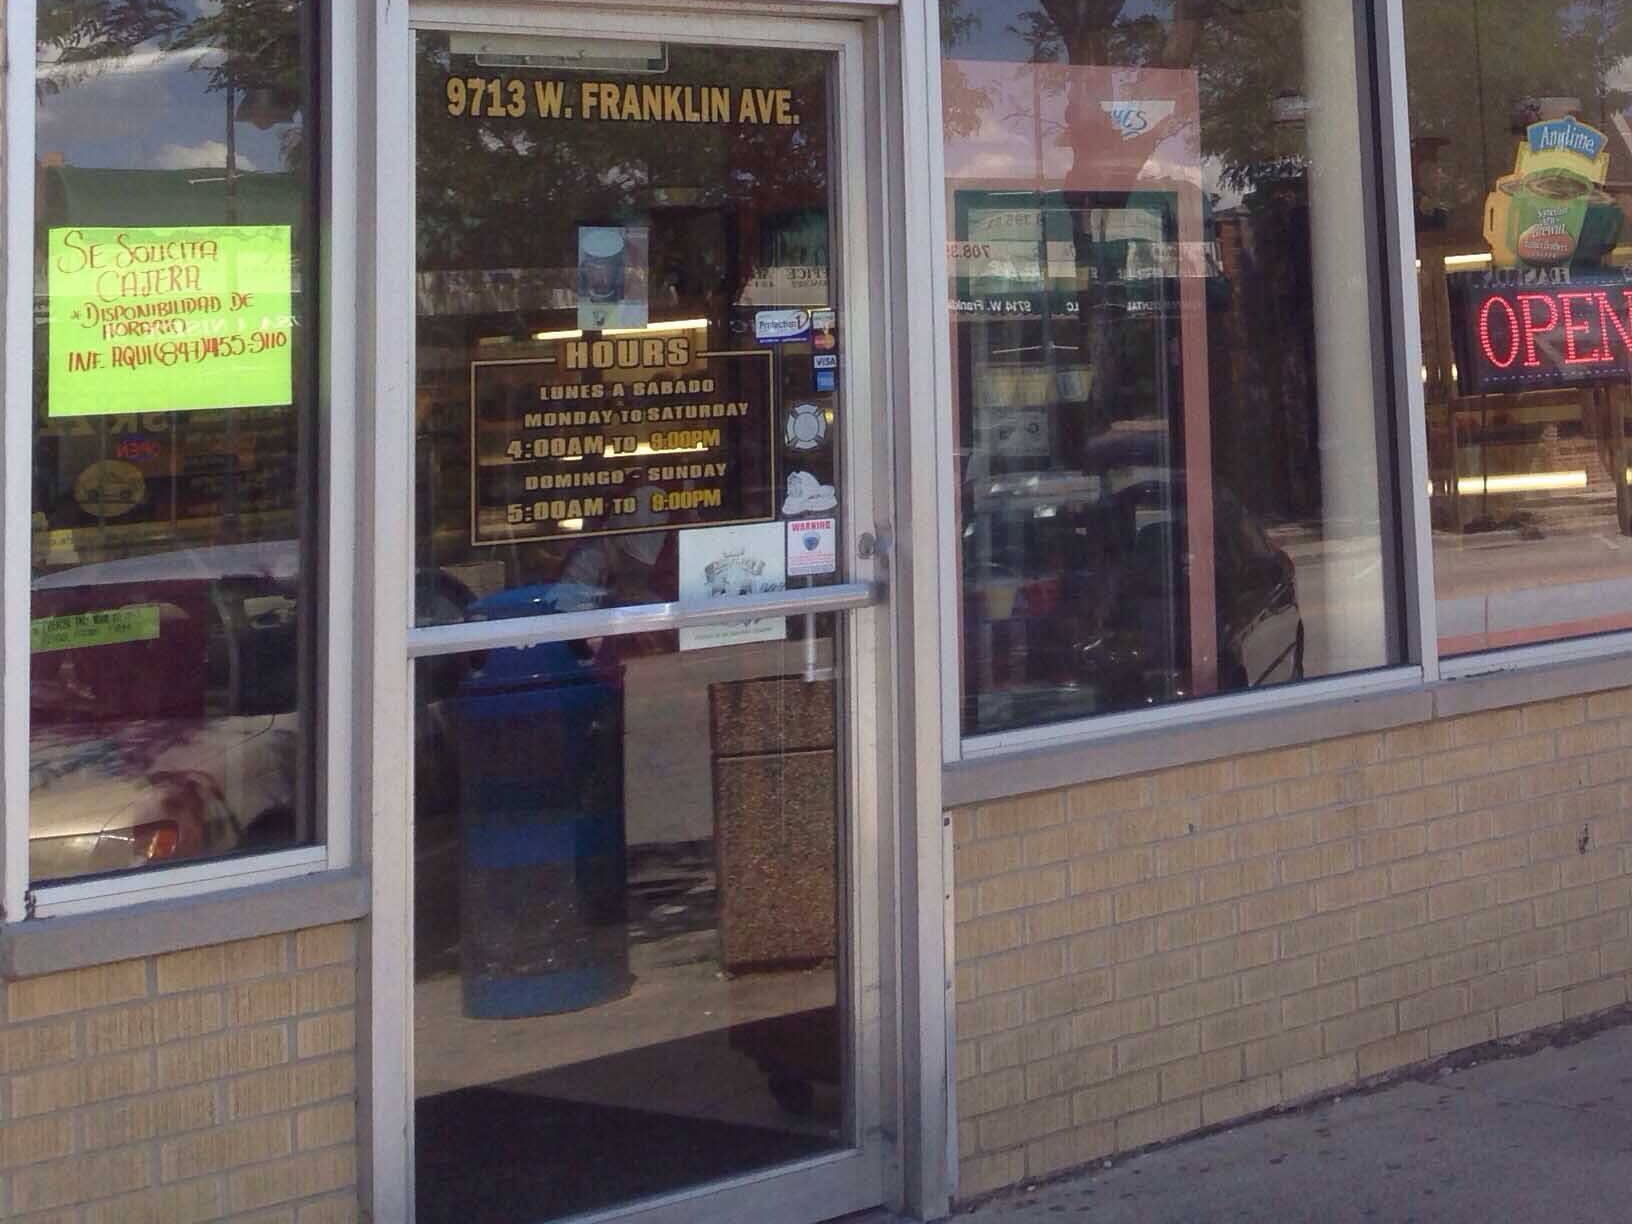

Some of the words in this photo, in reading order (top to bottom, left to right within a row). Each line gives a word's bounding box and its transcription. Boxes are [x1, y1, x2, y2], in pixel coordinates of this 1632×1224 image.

[446, 76, 526, 118] 9713
[534, 79, 572, 119] W.
[581, 82, 731, 124] FRANKLIN
[738, 87, 801, 125] AVE.
[57, 230, 104, 274] SE
[116, 233, 218, 269] SOLICITA
[96, 264, 203, 302] CAJERA
[81, 295, 222, 328] DISPONIBILIDAD
[230, 291, 254, 312] DE
[102, 317, 186, 340] HORARIO
[565, 337, 690, 369] HOURS
[816, 356, 836, 367] VISA
[540, 383, 604, 401] LUNES
[612, 383, 625, 397] A
[632, 379, 715, 397] SABADO
[524, 409, 613, 428] MONDAY
[620, 410, 641, 423] TO
[648, 402, 749, 422] SATURDAY
[507, 436, 603, 460] 4:00AM
[613, 436, 637, 454] TO
[650, 429, 721, 450] 9:00PM
[525, 470, 624, 491] DOMINGO
[648, 463, 727, 481] SUNDAY
[507, 497, 603, 523] 5:00AM
[612, 497, 636, 514] TO
[652, 489, 721, 512] 9:00PM
[791, 521, 831, 533] WARNING
